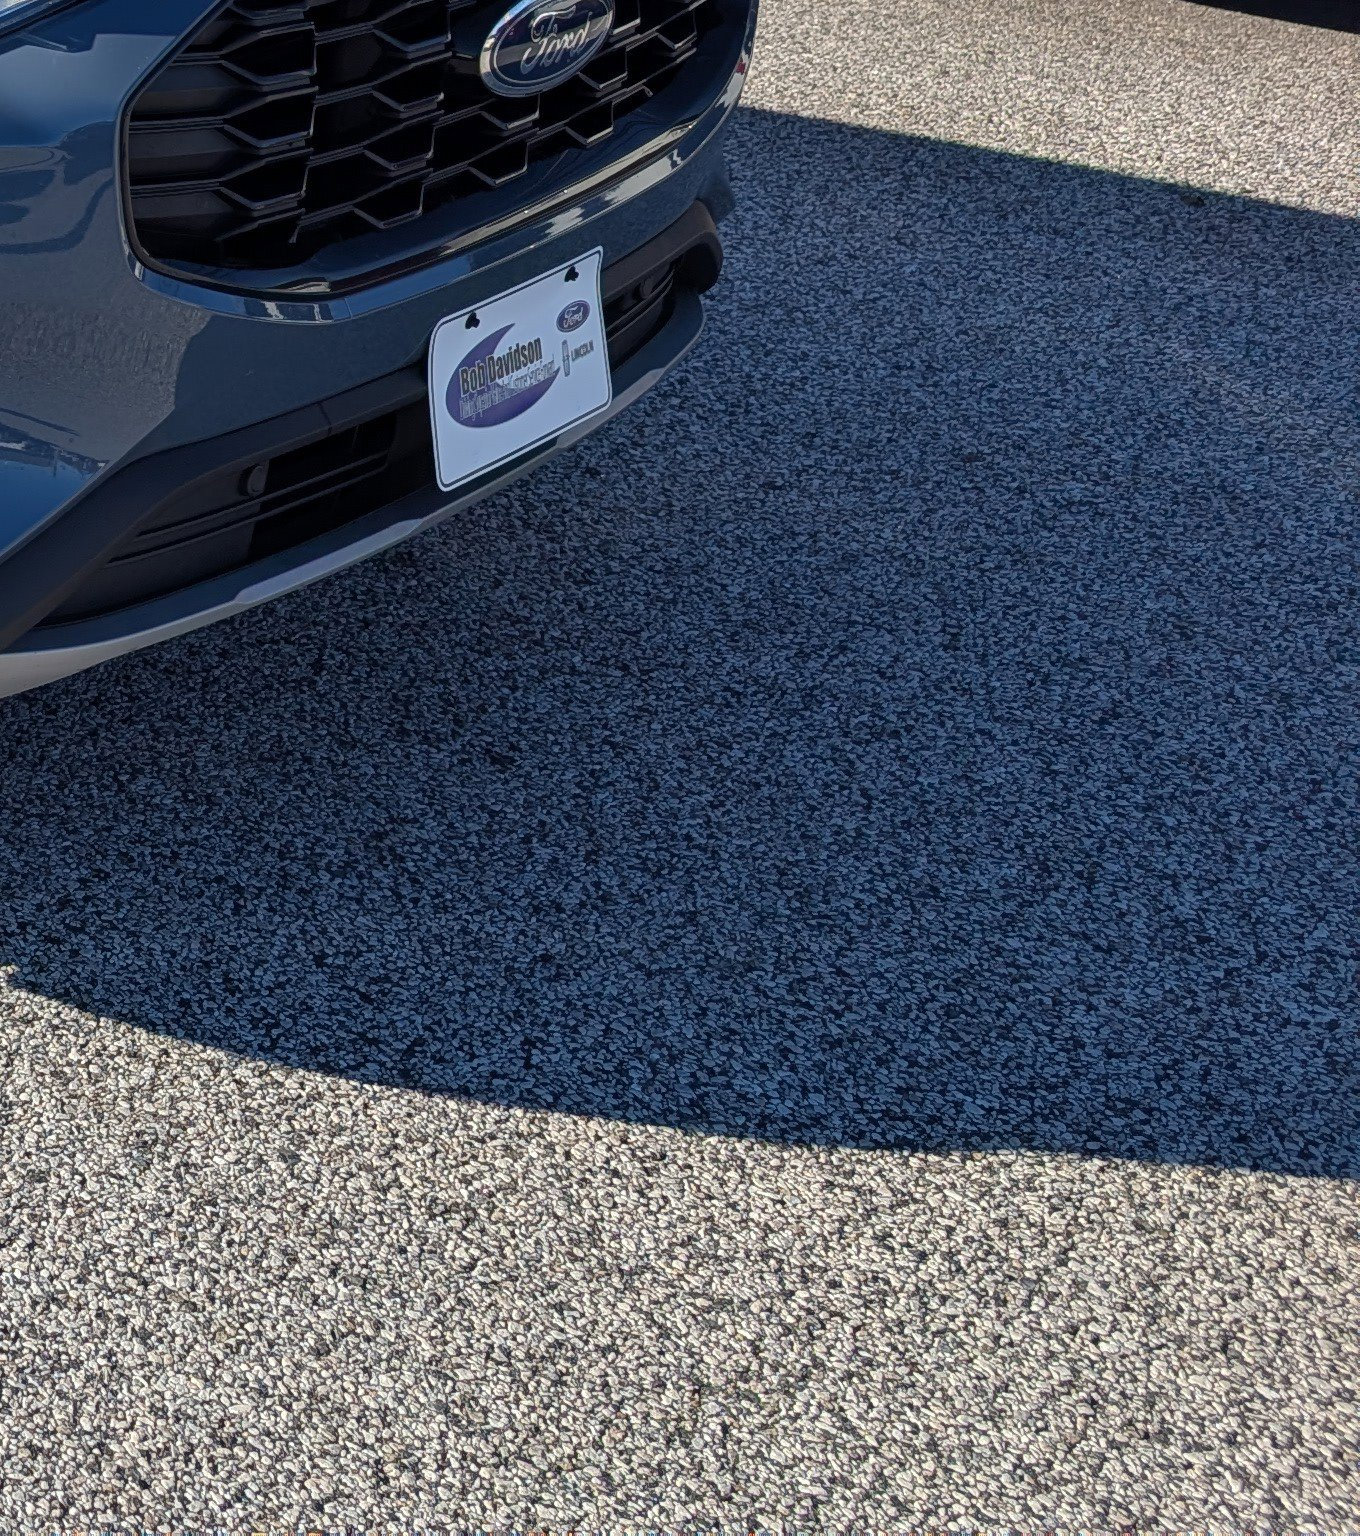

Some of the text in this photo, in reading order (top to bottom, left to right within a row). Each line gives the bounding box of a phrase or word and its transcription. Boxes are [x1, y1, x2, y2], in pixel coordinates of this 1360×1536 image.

[520, 5, 594, 75] Ford
[562, 305, 585, 329] Ford
[459, 360, 487, 397] Bob
[486, 337, 543, 383] Davidson
